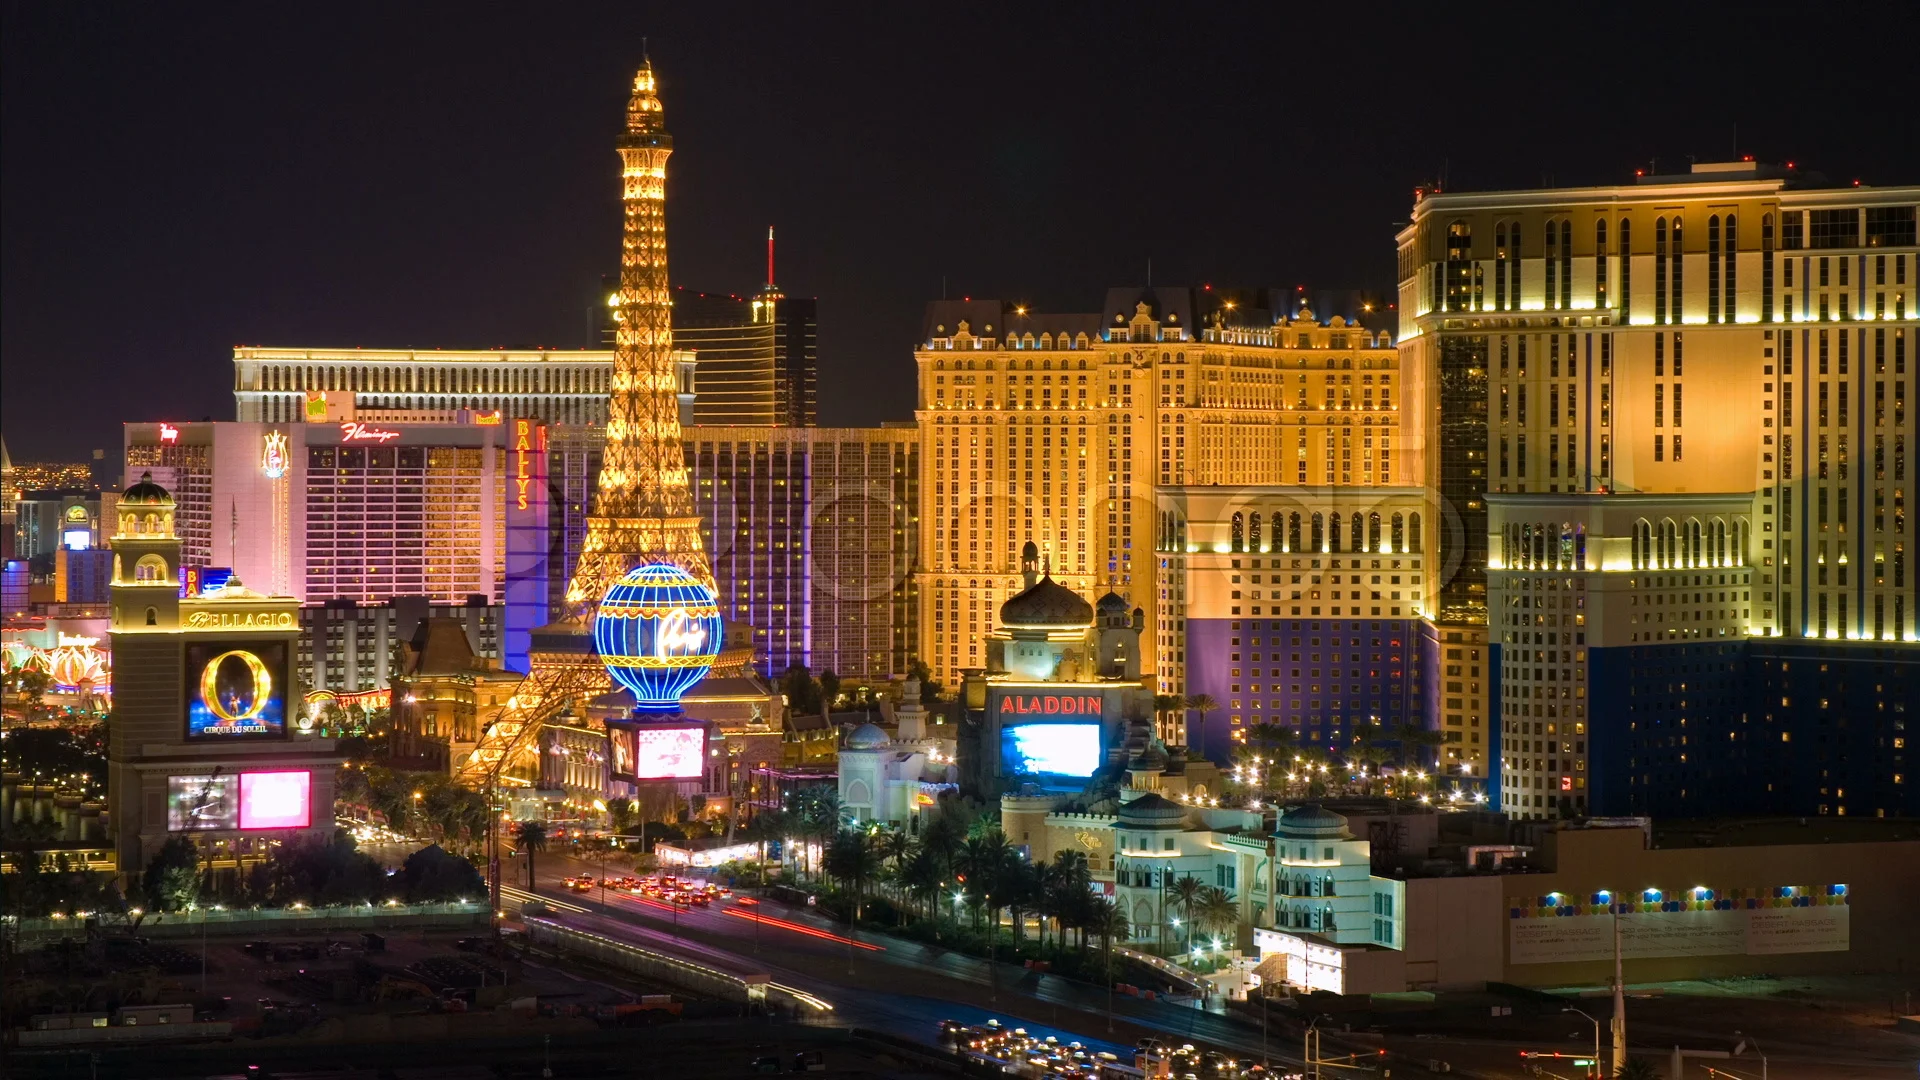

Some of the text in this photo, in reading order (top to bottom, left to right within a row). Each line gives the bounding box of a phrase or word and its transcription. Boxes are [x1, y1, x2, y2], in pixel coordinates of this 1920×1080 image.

[340, 422, 400, 443] Flamingo
[183, 611, 293, 628] BELLAGIO
[200, 649, 272, 721] O
[1000, 695, 1102, 715] ALADDIN
[203, 725, 268, 735] CIRQUE DU SOLEIL
[1751, 918, 1837, 929] DESERT PASSAGE
[1516, 927, 1601, 939] DESERT PASSAGE
